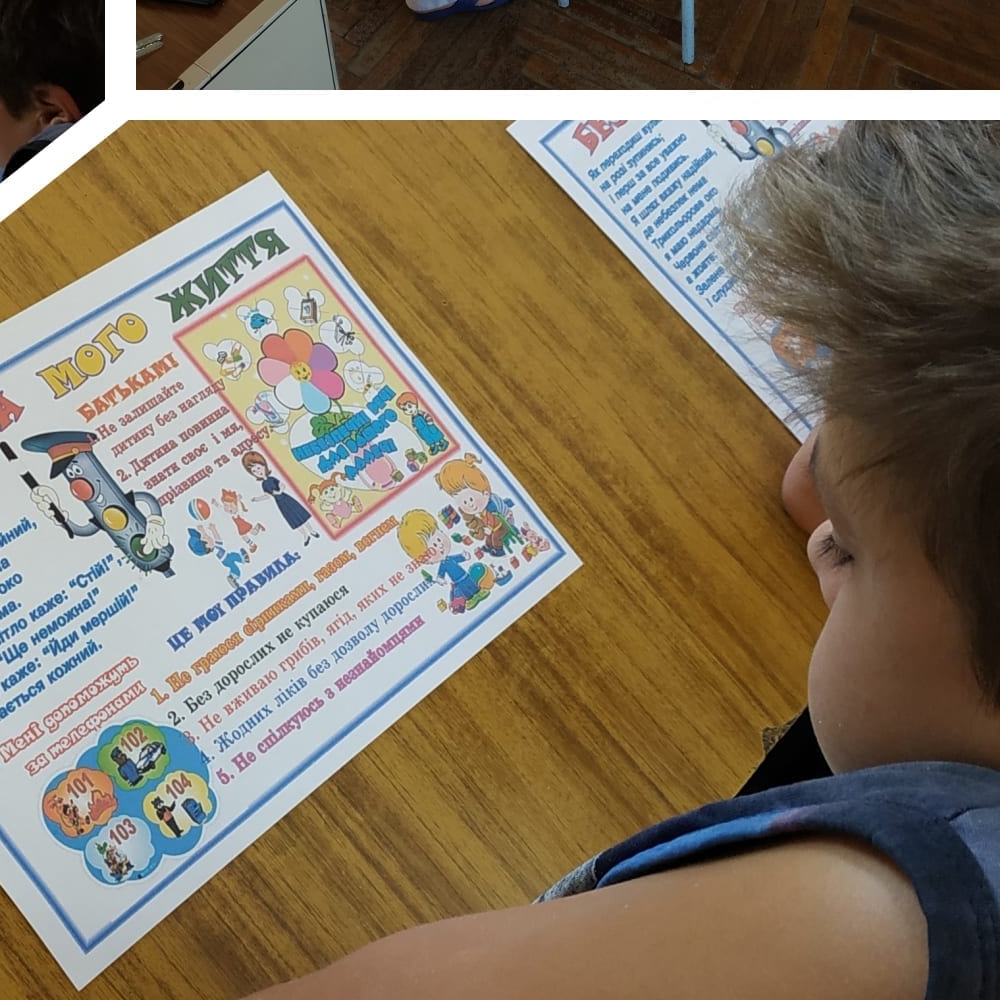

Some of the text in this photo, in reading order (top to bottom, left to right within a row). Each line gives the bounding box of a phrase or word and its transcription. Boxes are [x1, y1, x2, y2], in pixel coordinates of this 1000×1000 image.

[587, 167, 602, 181] Як
[631, 214, 642, 227] Я
[34, 312, 149, 400] МОГО
[154, 227, 291, 324] ЖИТТЯ
[94, 423, 118, 440] Не
[117, 381, 185, 427] залишайте
[110, 377, 229, 459] дитину без нагляду
[114, 403, 231, 482] 2. Дитина повинна
[143, 461, 181, 490] знати
[180, 443, 209, 466] своє
[208, 431, 221, 444] і
[152, 460, 217, 509] прізвище
[213, 454, 231, 468] та
[28, 589, 69, 623] каже:
[147, 683, 170, 706] 1.
[164, 670, 193, 694] Не
[190, 631, 245, 677] граюся
[313, 549, 357, 584] газом,
[353, 515, 402, 553] вогнем
[166, 546, 303, 653] ЦЕ МОЇ ПРАВИЛА:
[46, 639, 103, 685] кожний.
[164, 585, 350, 727] 2. Без дорослих не купаюся
[197, 713, 223, 733] Не
[222, 670, 278, 716] вживаю
[278, 636, 326, 673] грибів,
[325, 611, 358, 637] ягід,
[356, 583, 389, 613] яких
[388, 571, 405, 587] не
[403, 544, 439, 575] знаю
[0, 657, 42, 692] каже:
[42, 656, 140, 734] допоможуть
[195, 745, 216, 767] 4.
[213, 704, 274, 753] Жодних
[274, 677, 308, 708] ліків
[306, 658, 331, 679] без
[330, 618, 380, 665] дозволу
[213, 614, 426, 786] 5. Не спілкуюсь з незнайомцями
[24, 679, 148, 777] за телефонами
[117, 724, 149, 755] 102
[63, 770, 96, 801] 101
[162, 770, 194, 801] 104
[106, 815, 139, 848] 103
